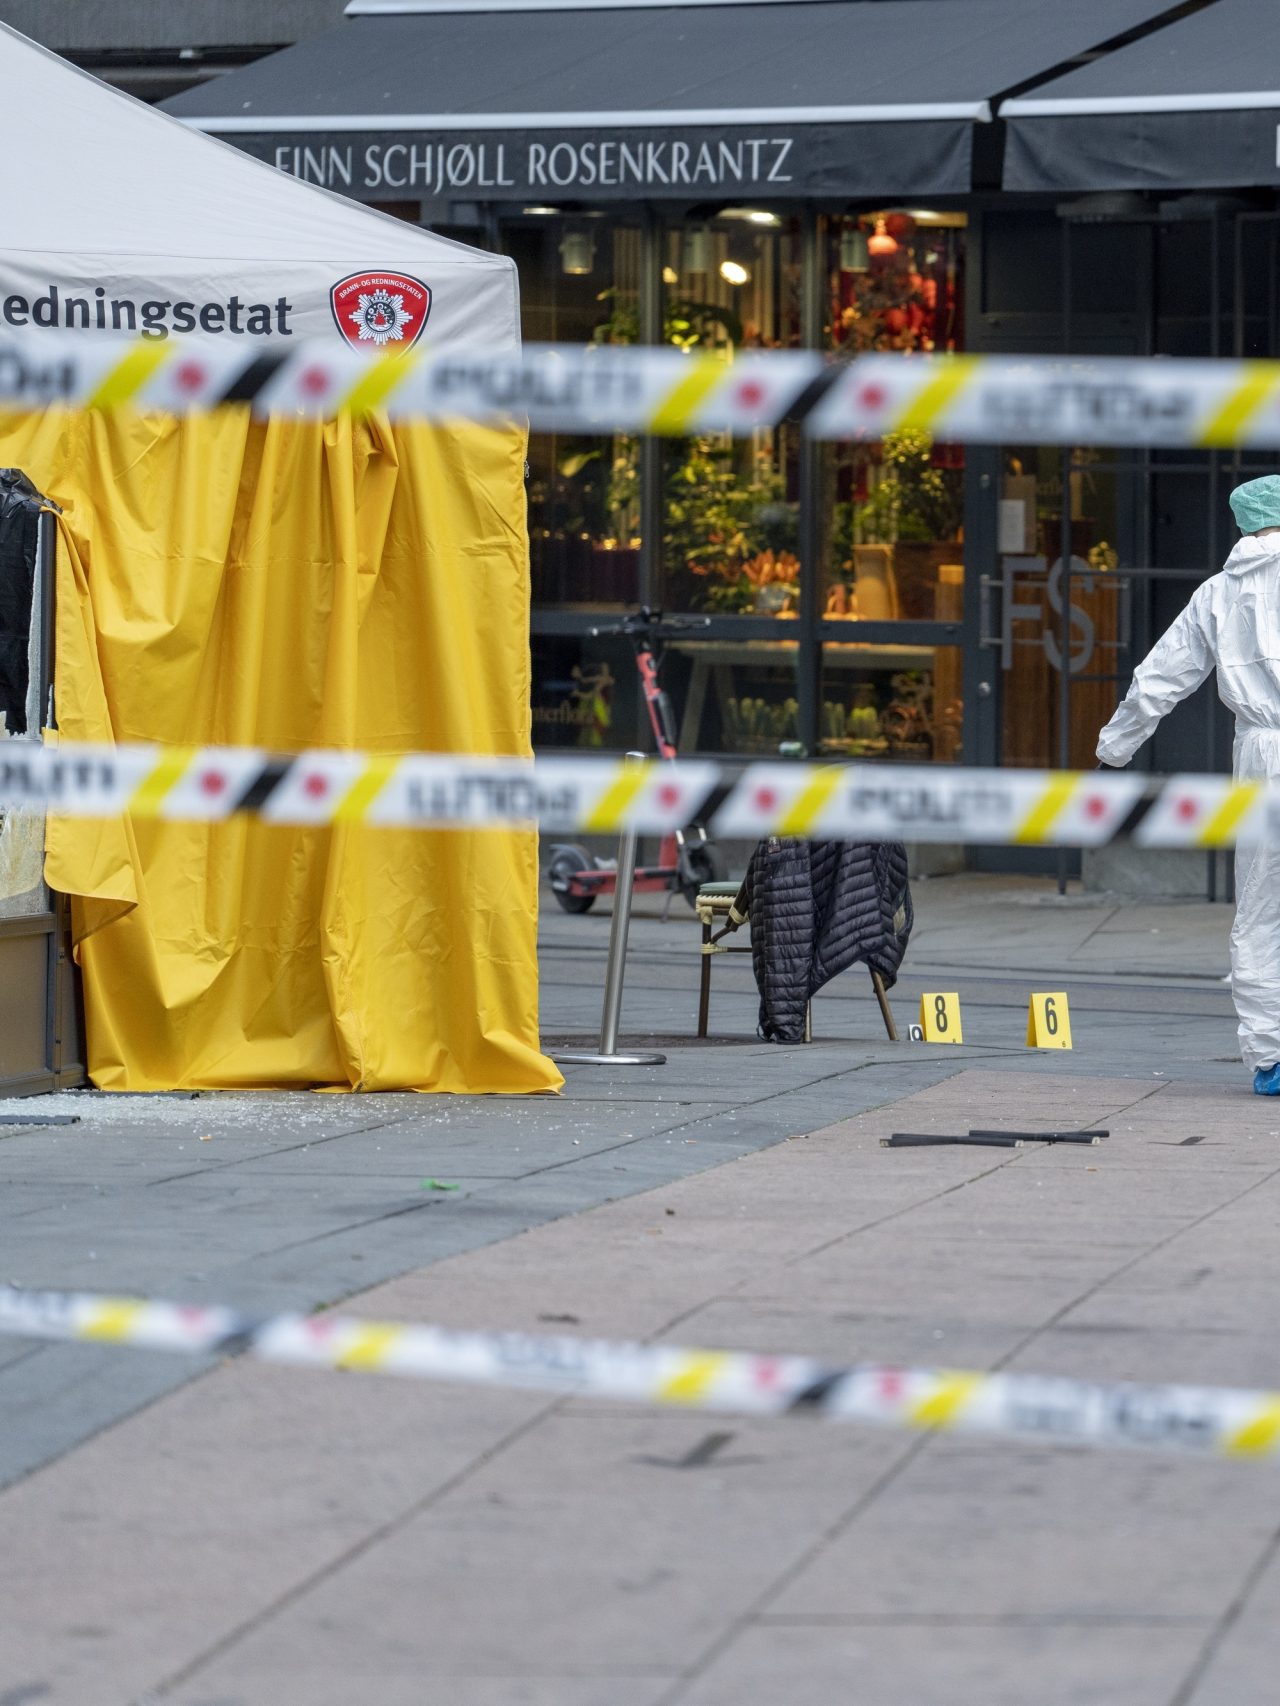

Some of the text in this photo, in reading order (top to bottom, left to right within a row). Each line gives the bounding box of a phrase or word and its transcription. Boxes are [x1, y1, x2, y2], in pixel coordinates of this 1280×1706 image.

[275, 138, 794, 195] FINN SCHJØLL ROSENKRANTZ
[361, 279, 371, 287] OG
[371, 278, 423, 300] REDNINGSETATEN
[2, 285, 293, 342] edningsetat
[1001, 554, 1095, 674] FS
[934, 995, 948, 1033] 8
[1044, 997, 1058, 1035] 6
